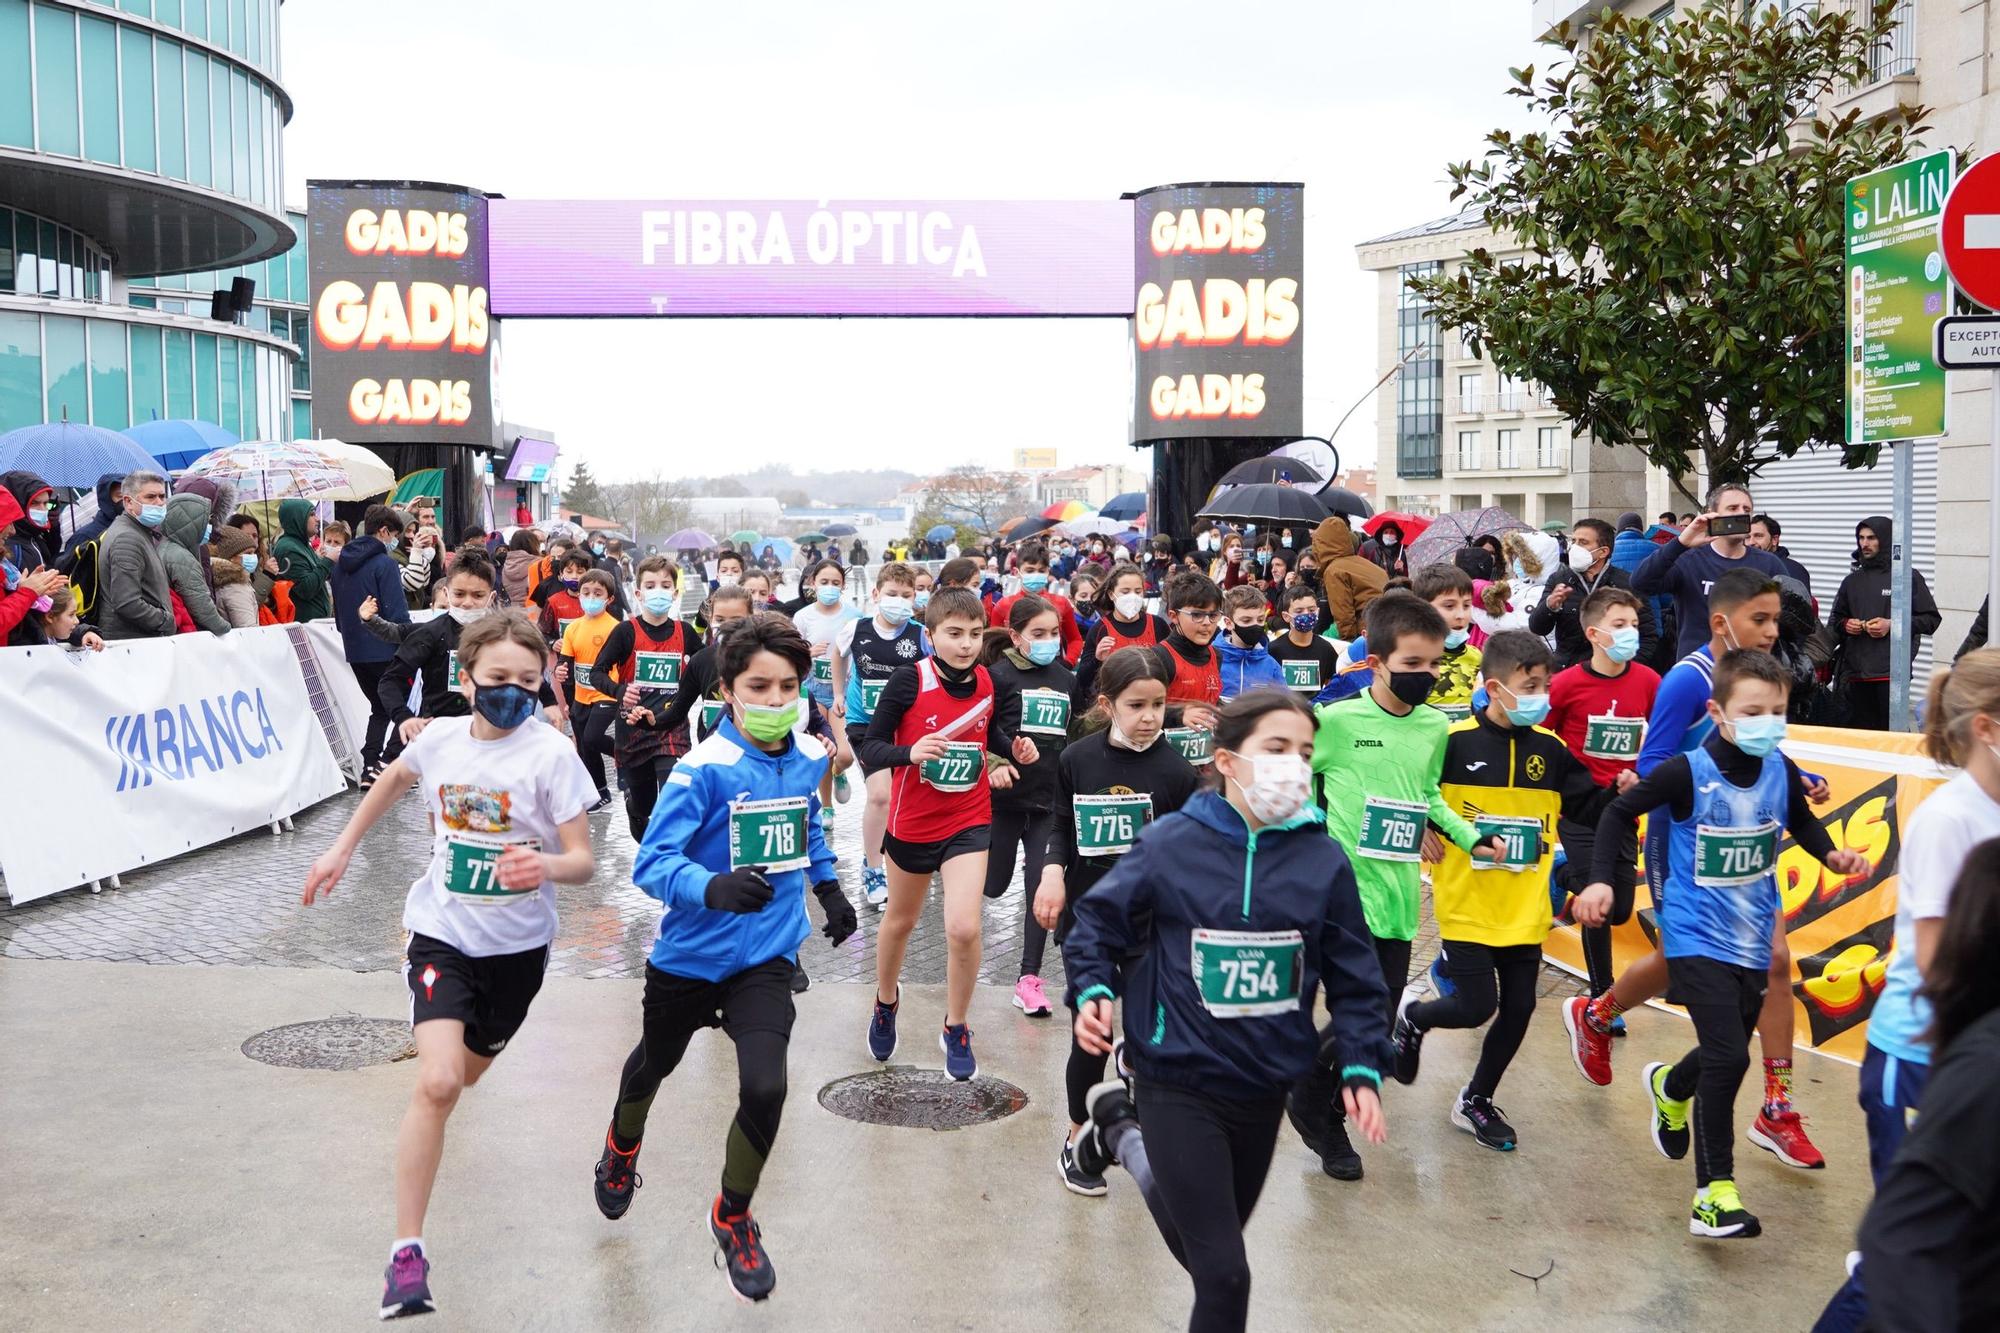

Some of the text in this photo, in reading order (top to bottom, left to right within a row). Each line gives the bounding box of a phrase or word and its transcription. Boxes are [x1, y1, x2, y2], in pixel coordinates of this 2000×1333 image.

[1874, 162, 1944, 225] LALÍN
[344, 208, 469, 257] GADIS
[642, 199, 988, 277] FIBRA ÓPTICA
[1150, 206, 1267, 257] GADIS
[316, 279, 489, 354] GADIS
[1136, 277, 1301, 351] GADIS
[1950, 331, 2000, 341] EXCEPT
[349, 378, 472, 425] GADIS
[1150, 373, 1267, 421] GADIS
[648, 663, 672, 681] 747
[1293, 670, 1310, 685] 781
[1037, 703, 1062, 725] 772
[105, 687, 283, 792] ABANCA
[1180, 738, 1206, 757] 737
[1602, 730, 1632, 752] 773
[938, 758, 972, 781] 722
[768, 814, 788, 823] DAVID
[1089, 814, 1133, 842] 776
[1381, 818, 1416, 848] 769
[733, 821, 741, 858] SUB 12
[759, 822, 795, 857] 718
[1500, 833, 1524, 860] 711
[467, 858, 509, 890] 77
[1719, 845, 1764, 873] 704
[1220, 959, 1279, 999] 754
